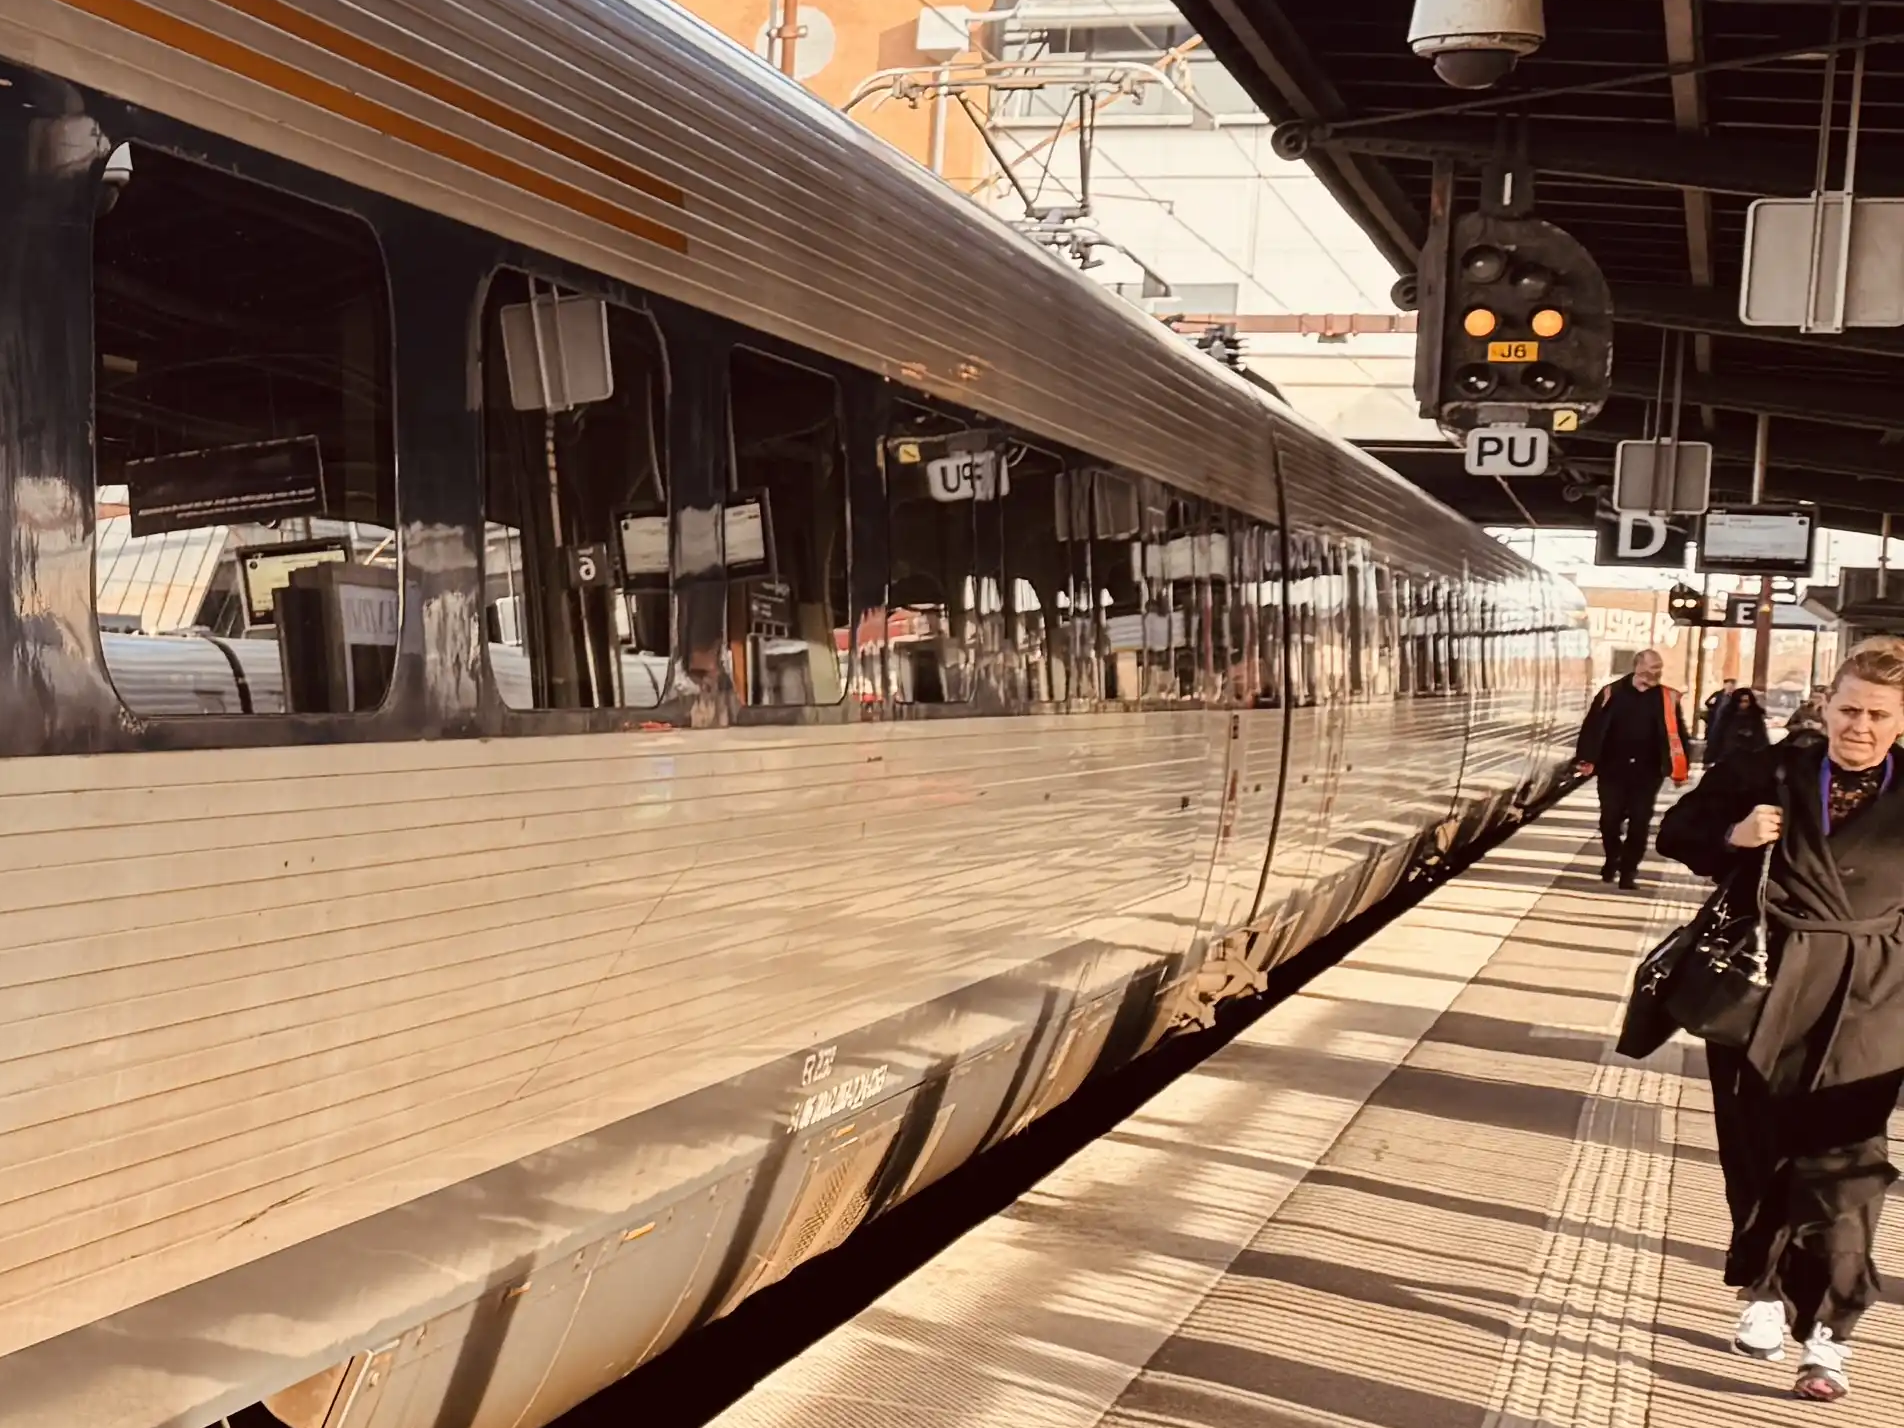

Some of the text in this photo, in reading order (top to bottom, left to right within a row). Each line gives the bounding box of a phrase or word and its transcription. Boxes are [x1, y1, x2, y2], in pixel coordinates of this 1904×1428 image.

[1476, 436, 1538, 468] PU
[1617, 510, 1668, 558] D
[1736, 602, 1756, 626] E
